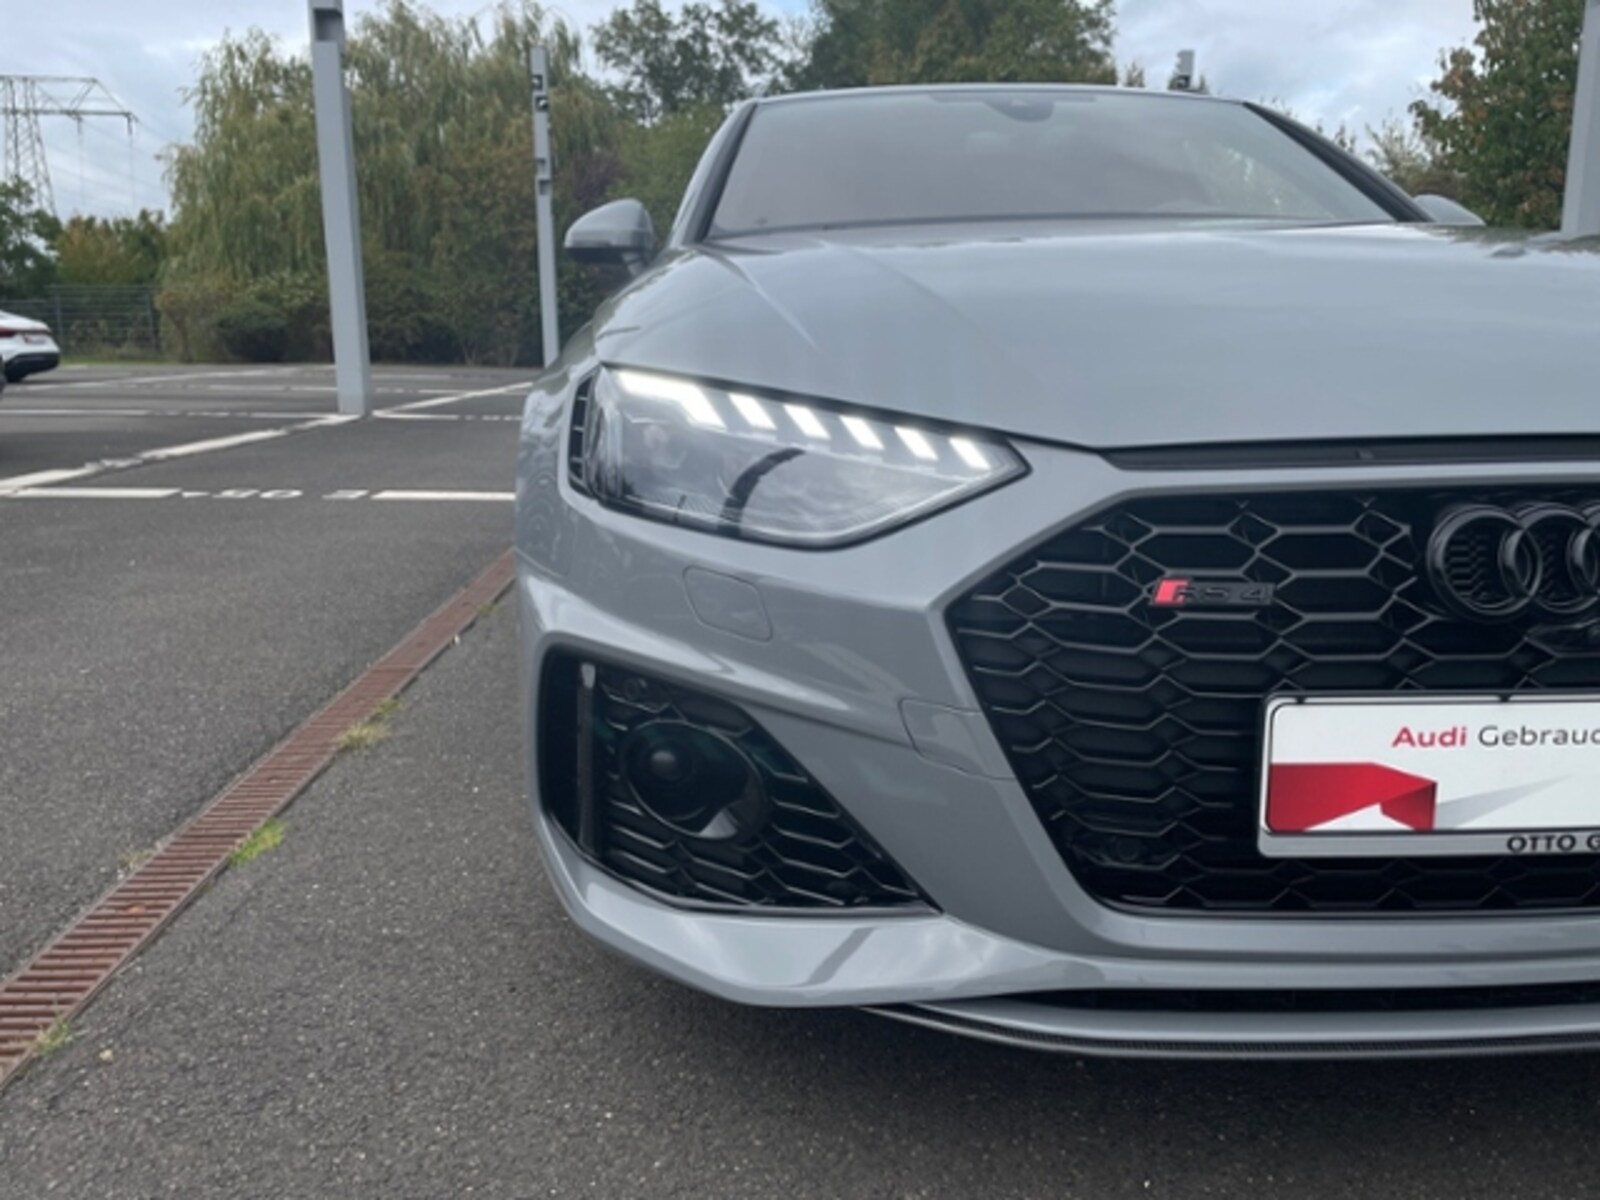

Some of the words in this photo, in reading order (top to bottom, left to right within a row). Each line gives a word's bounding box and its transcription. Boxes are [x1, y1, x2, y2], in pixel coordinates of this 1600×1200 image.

[1391, 726, 1468, 748] Audi
[1477, 724, 1600, 747] Gebrauc
[1506, 834, 1577, 853] OTTO
